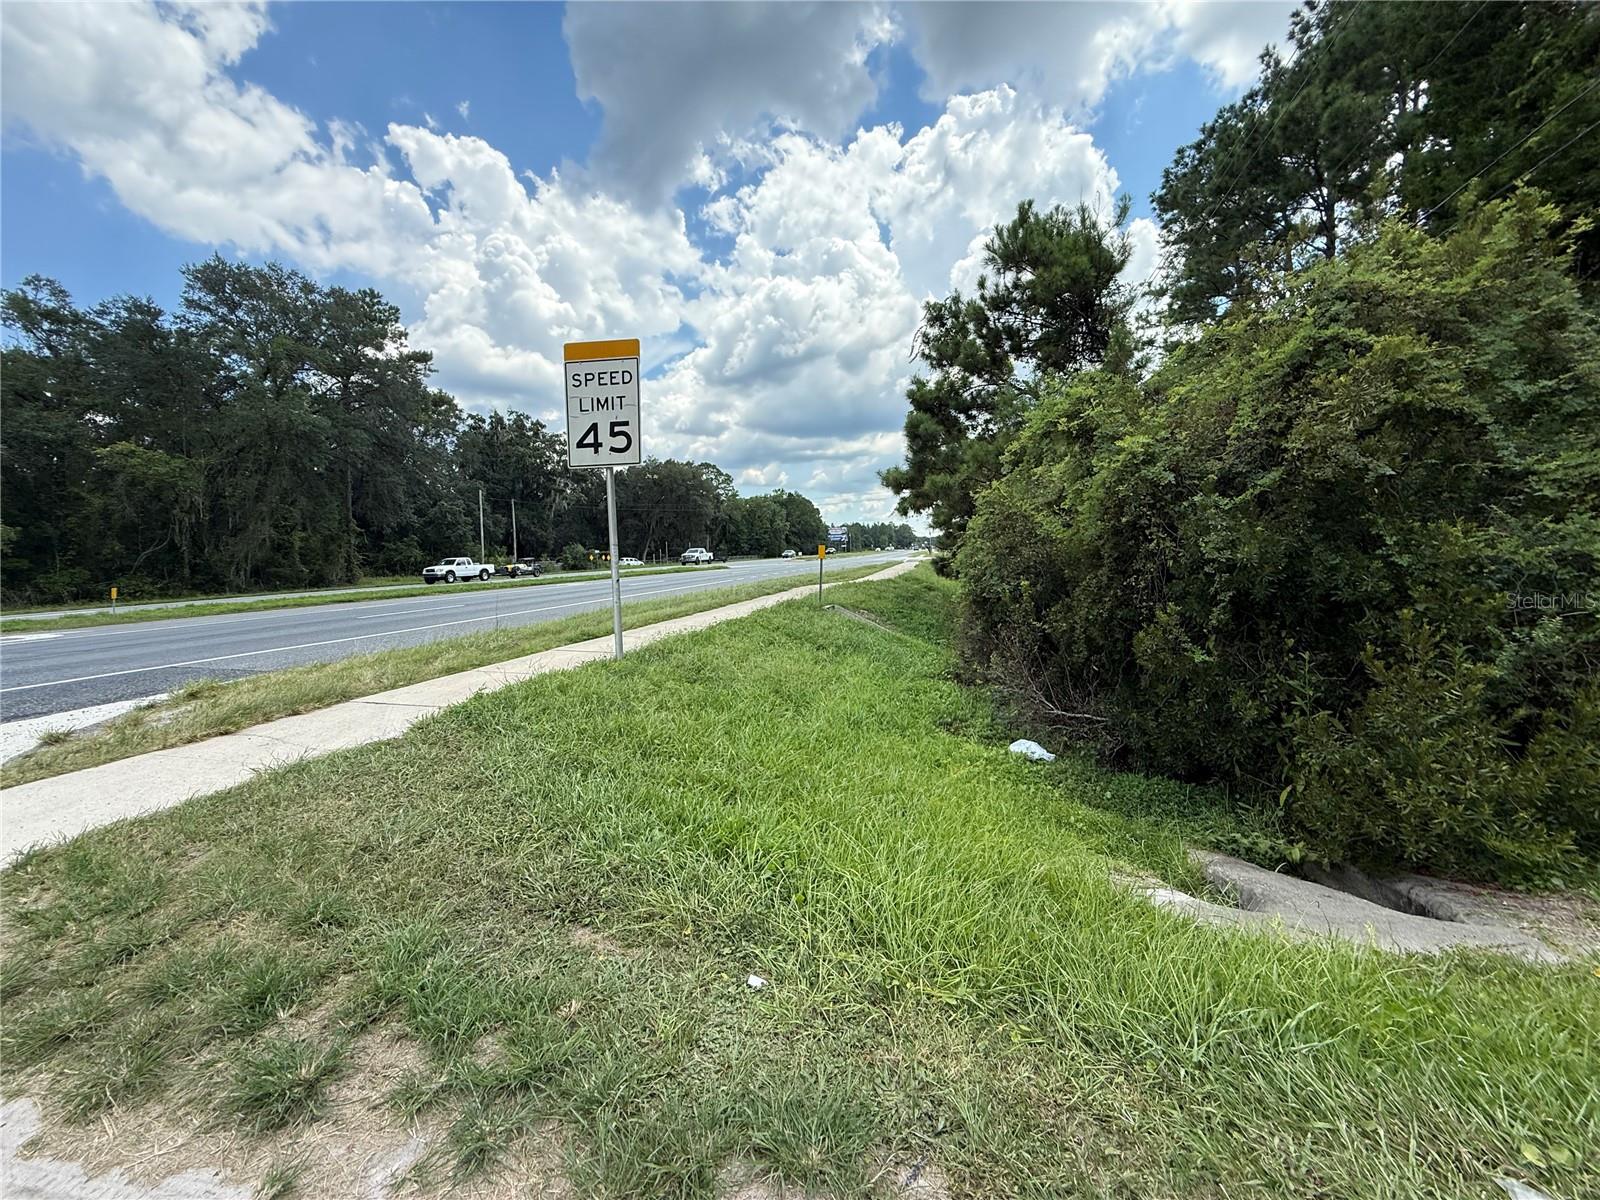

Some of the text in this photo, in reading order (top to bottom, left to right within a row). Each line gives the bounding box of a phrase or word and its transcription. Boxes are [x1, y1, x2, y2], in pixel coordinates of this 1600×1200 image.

[572, 370, 633, 388] SPEED
[579, 395, 626, 412] LIMIT
[576, 420, 632, 454] 45
